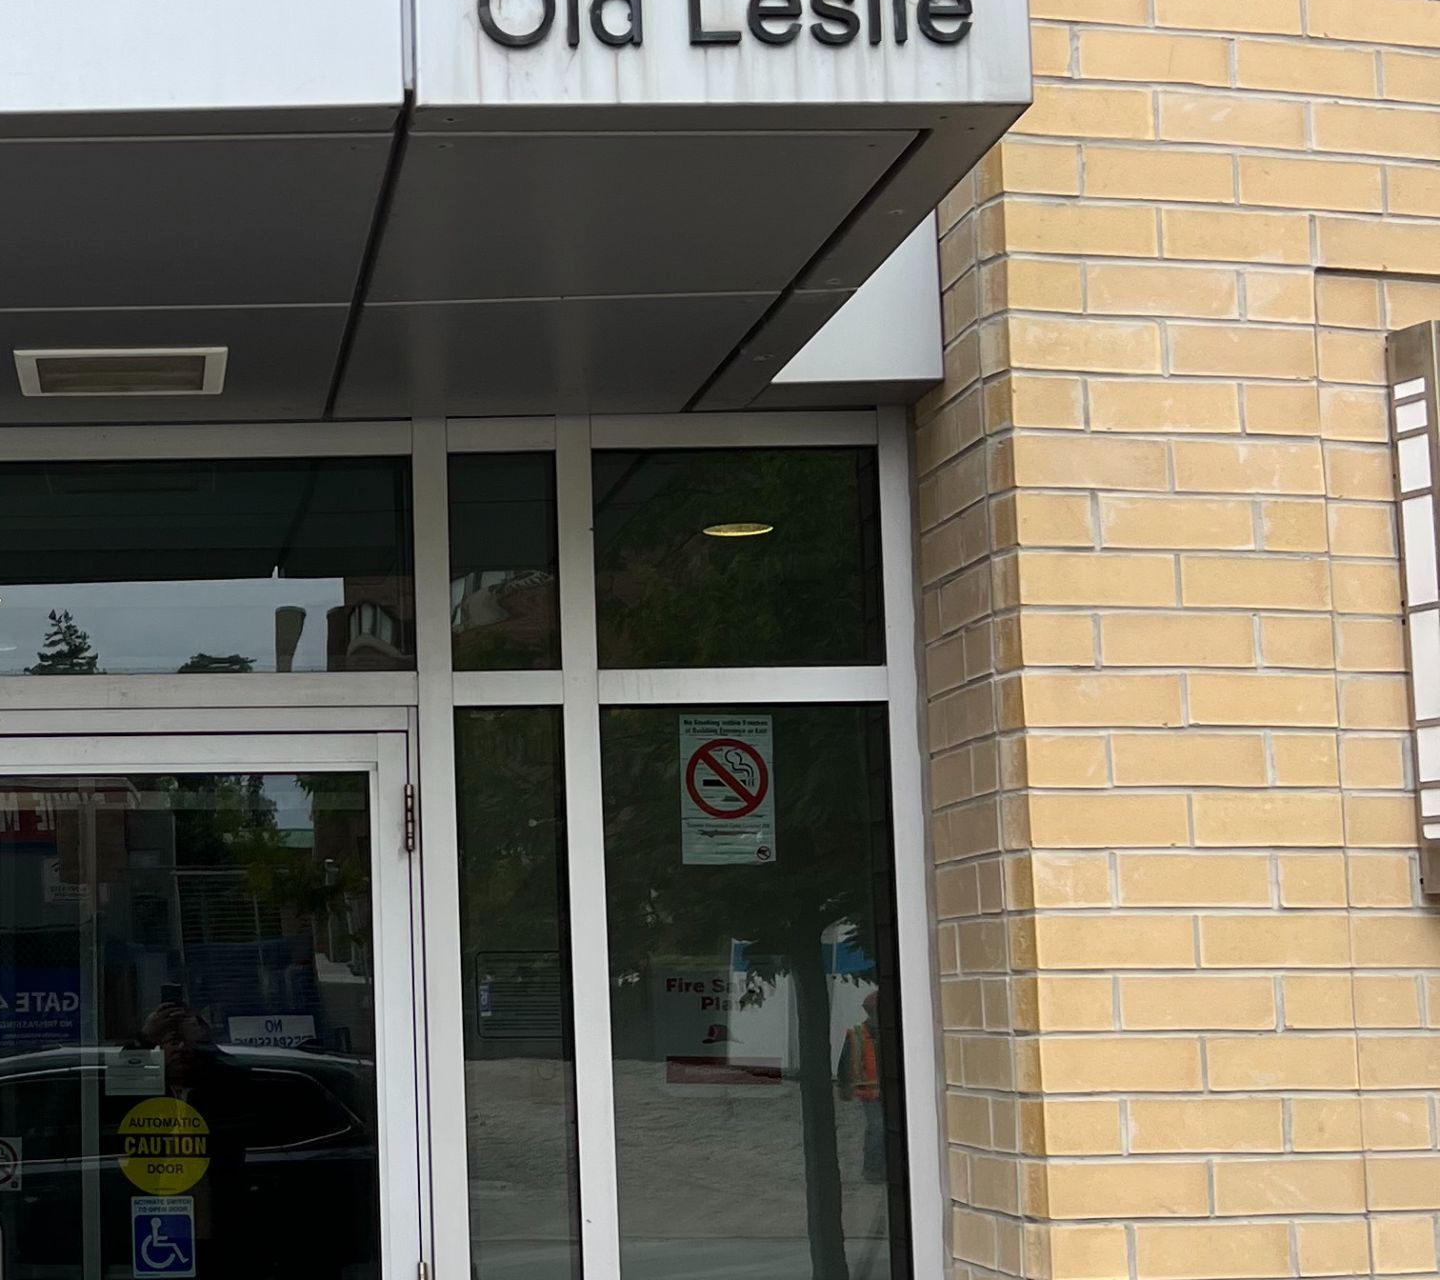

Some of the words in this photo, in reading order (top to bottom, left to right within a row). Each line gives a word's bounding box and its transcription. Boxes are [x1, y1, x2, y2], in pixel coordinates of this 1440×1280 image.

[666, 979, 705, 993] Fire
[129, 1117, 201, 1128] AUTOMATIC
[124, 1136, 207, 1155] CAUTION
[147, 1164, 184, 1174] DOOR
